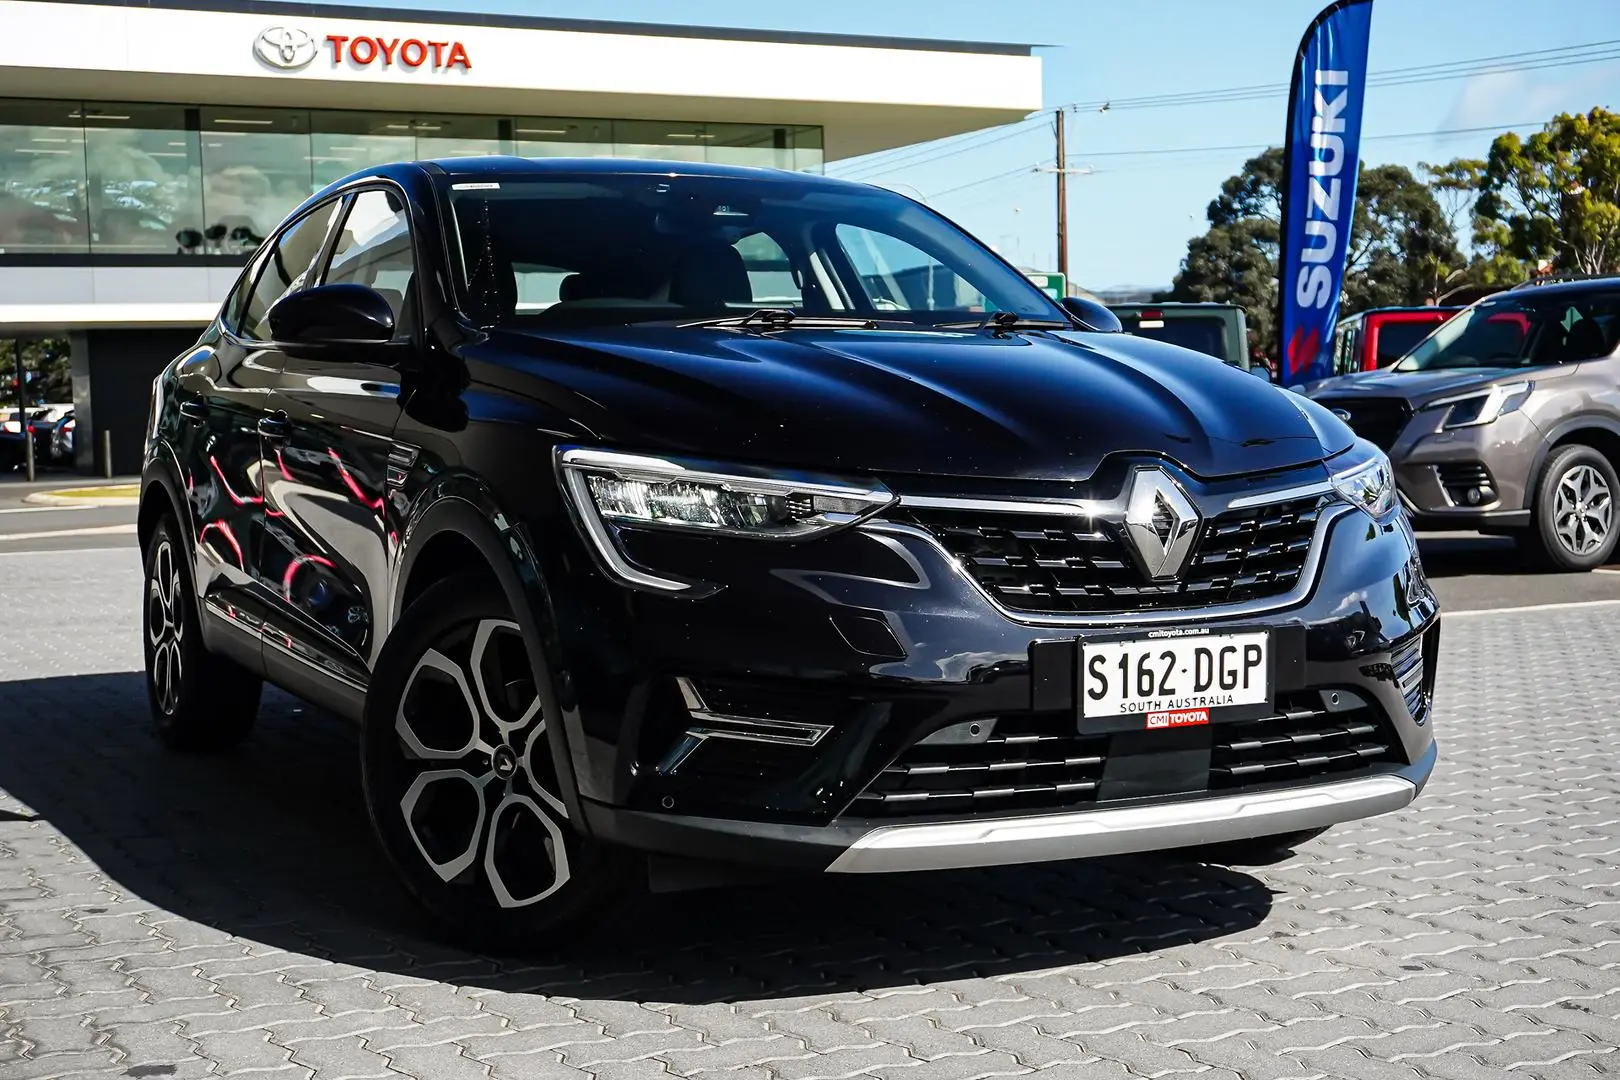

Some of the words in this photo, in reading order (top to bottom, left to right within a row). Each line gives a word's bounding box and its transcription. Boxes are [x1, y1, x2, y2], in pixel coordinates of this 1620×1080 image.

[326, 35, 472, 70] TOYOTA
[1296, 69, 1348, 309] SUZUKI
[1148, 628, 1210, 638] cmitoyota.com.au
[1120, 701, 1162, 713] SOUTH
[1167, 695, 1234, 709] AUSTRALIA
[1149, 714, 1168, 725] CMI
[1169, 710, 1208, 724] TOYOTA
